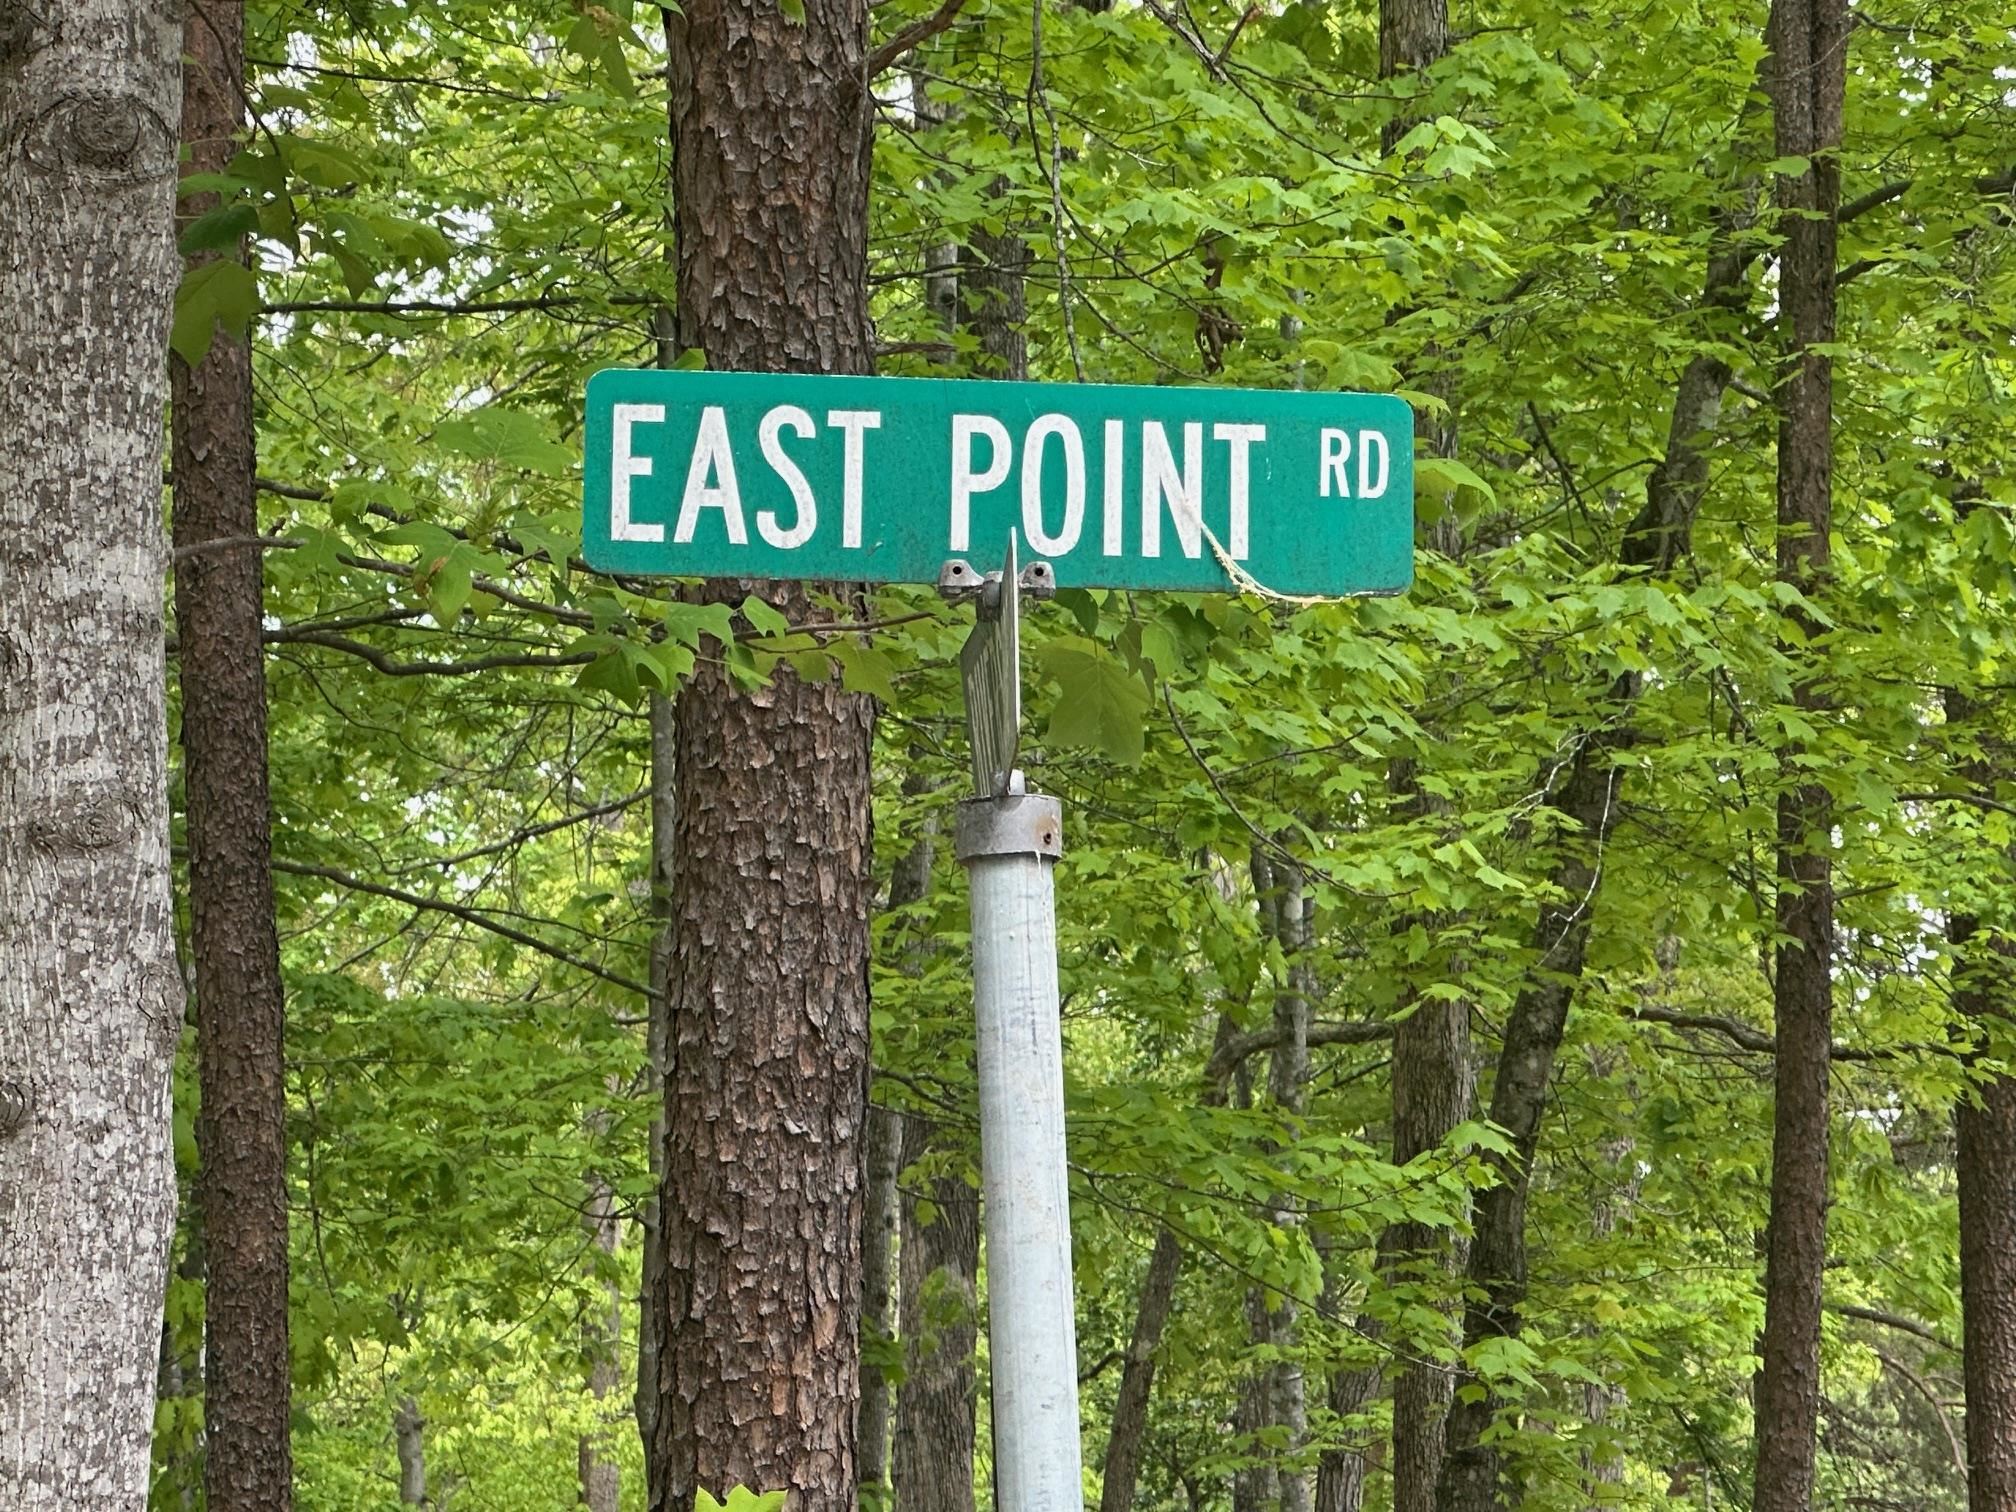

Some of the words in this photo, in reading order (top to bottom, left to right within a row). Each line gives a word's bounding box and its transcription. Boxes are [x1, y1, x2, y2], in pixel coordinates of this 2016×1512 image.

[611, 404, 882, 549] EAST
[951, 414, 1266, 561] POINT
[1319, 428, 1390, 499] RD
